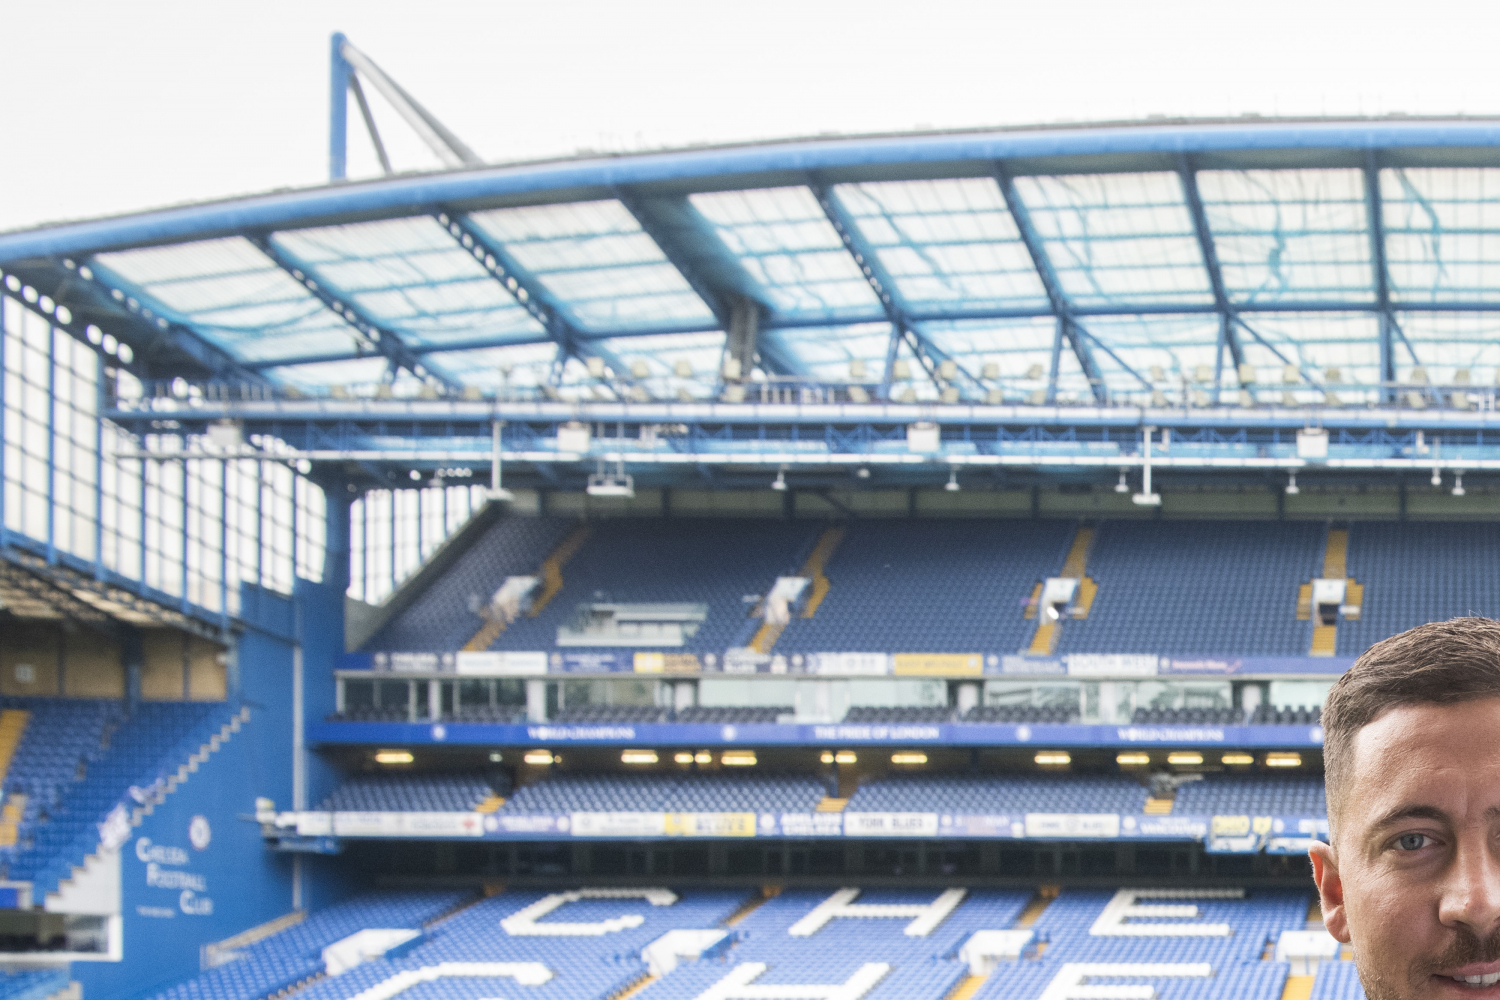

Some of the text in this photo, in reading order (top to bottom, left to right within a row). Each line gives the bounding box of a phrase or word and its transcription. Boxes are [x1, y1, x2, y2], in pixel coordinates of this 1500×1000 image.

[814, 726, 940, 740] THE PRIDE OF LONDON
